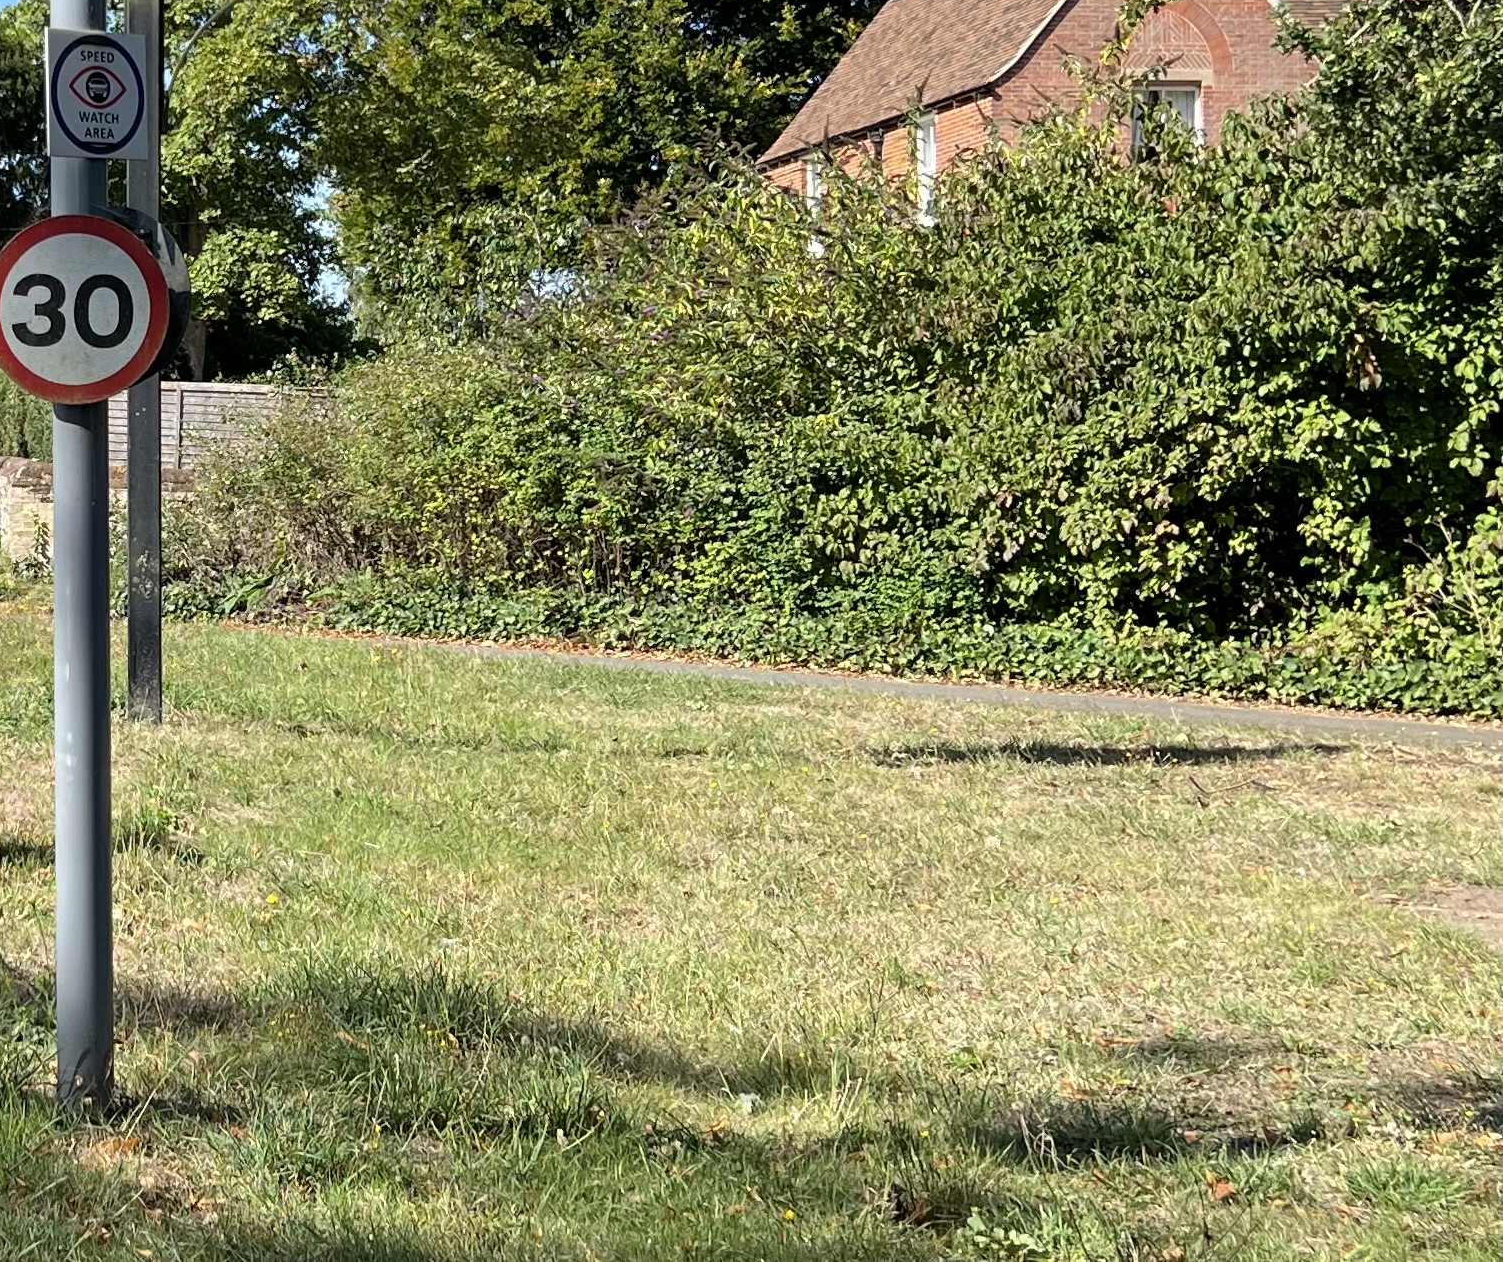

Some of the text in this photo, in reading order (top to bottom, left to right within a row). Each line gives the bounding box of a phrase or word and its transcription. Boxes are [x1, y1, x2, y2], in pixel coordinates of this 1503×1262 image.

[80, 50, 115, 64] SPEED
[78, 111, 120, 125] WATCH
[84, 127, 116, 140] AREA
[11, 273, 134, 349] 30
